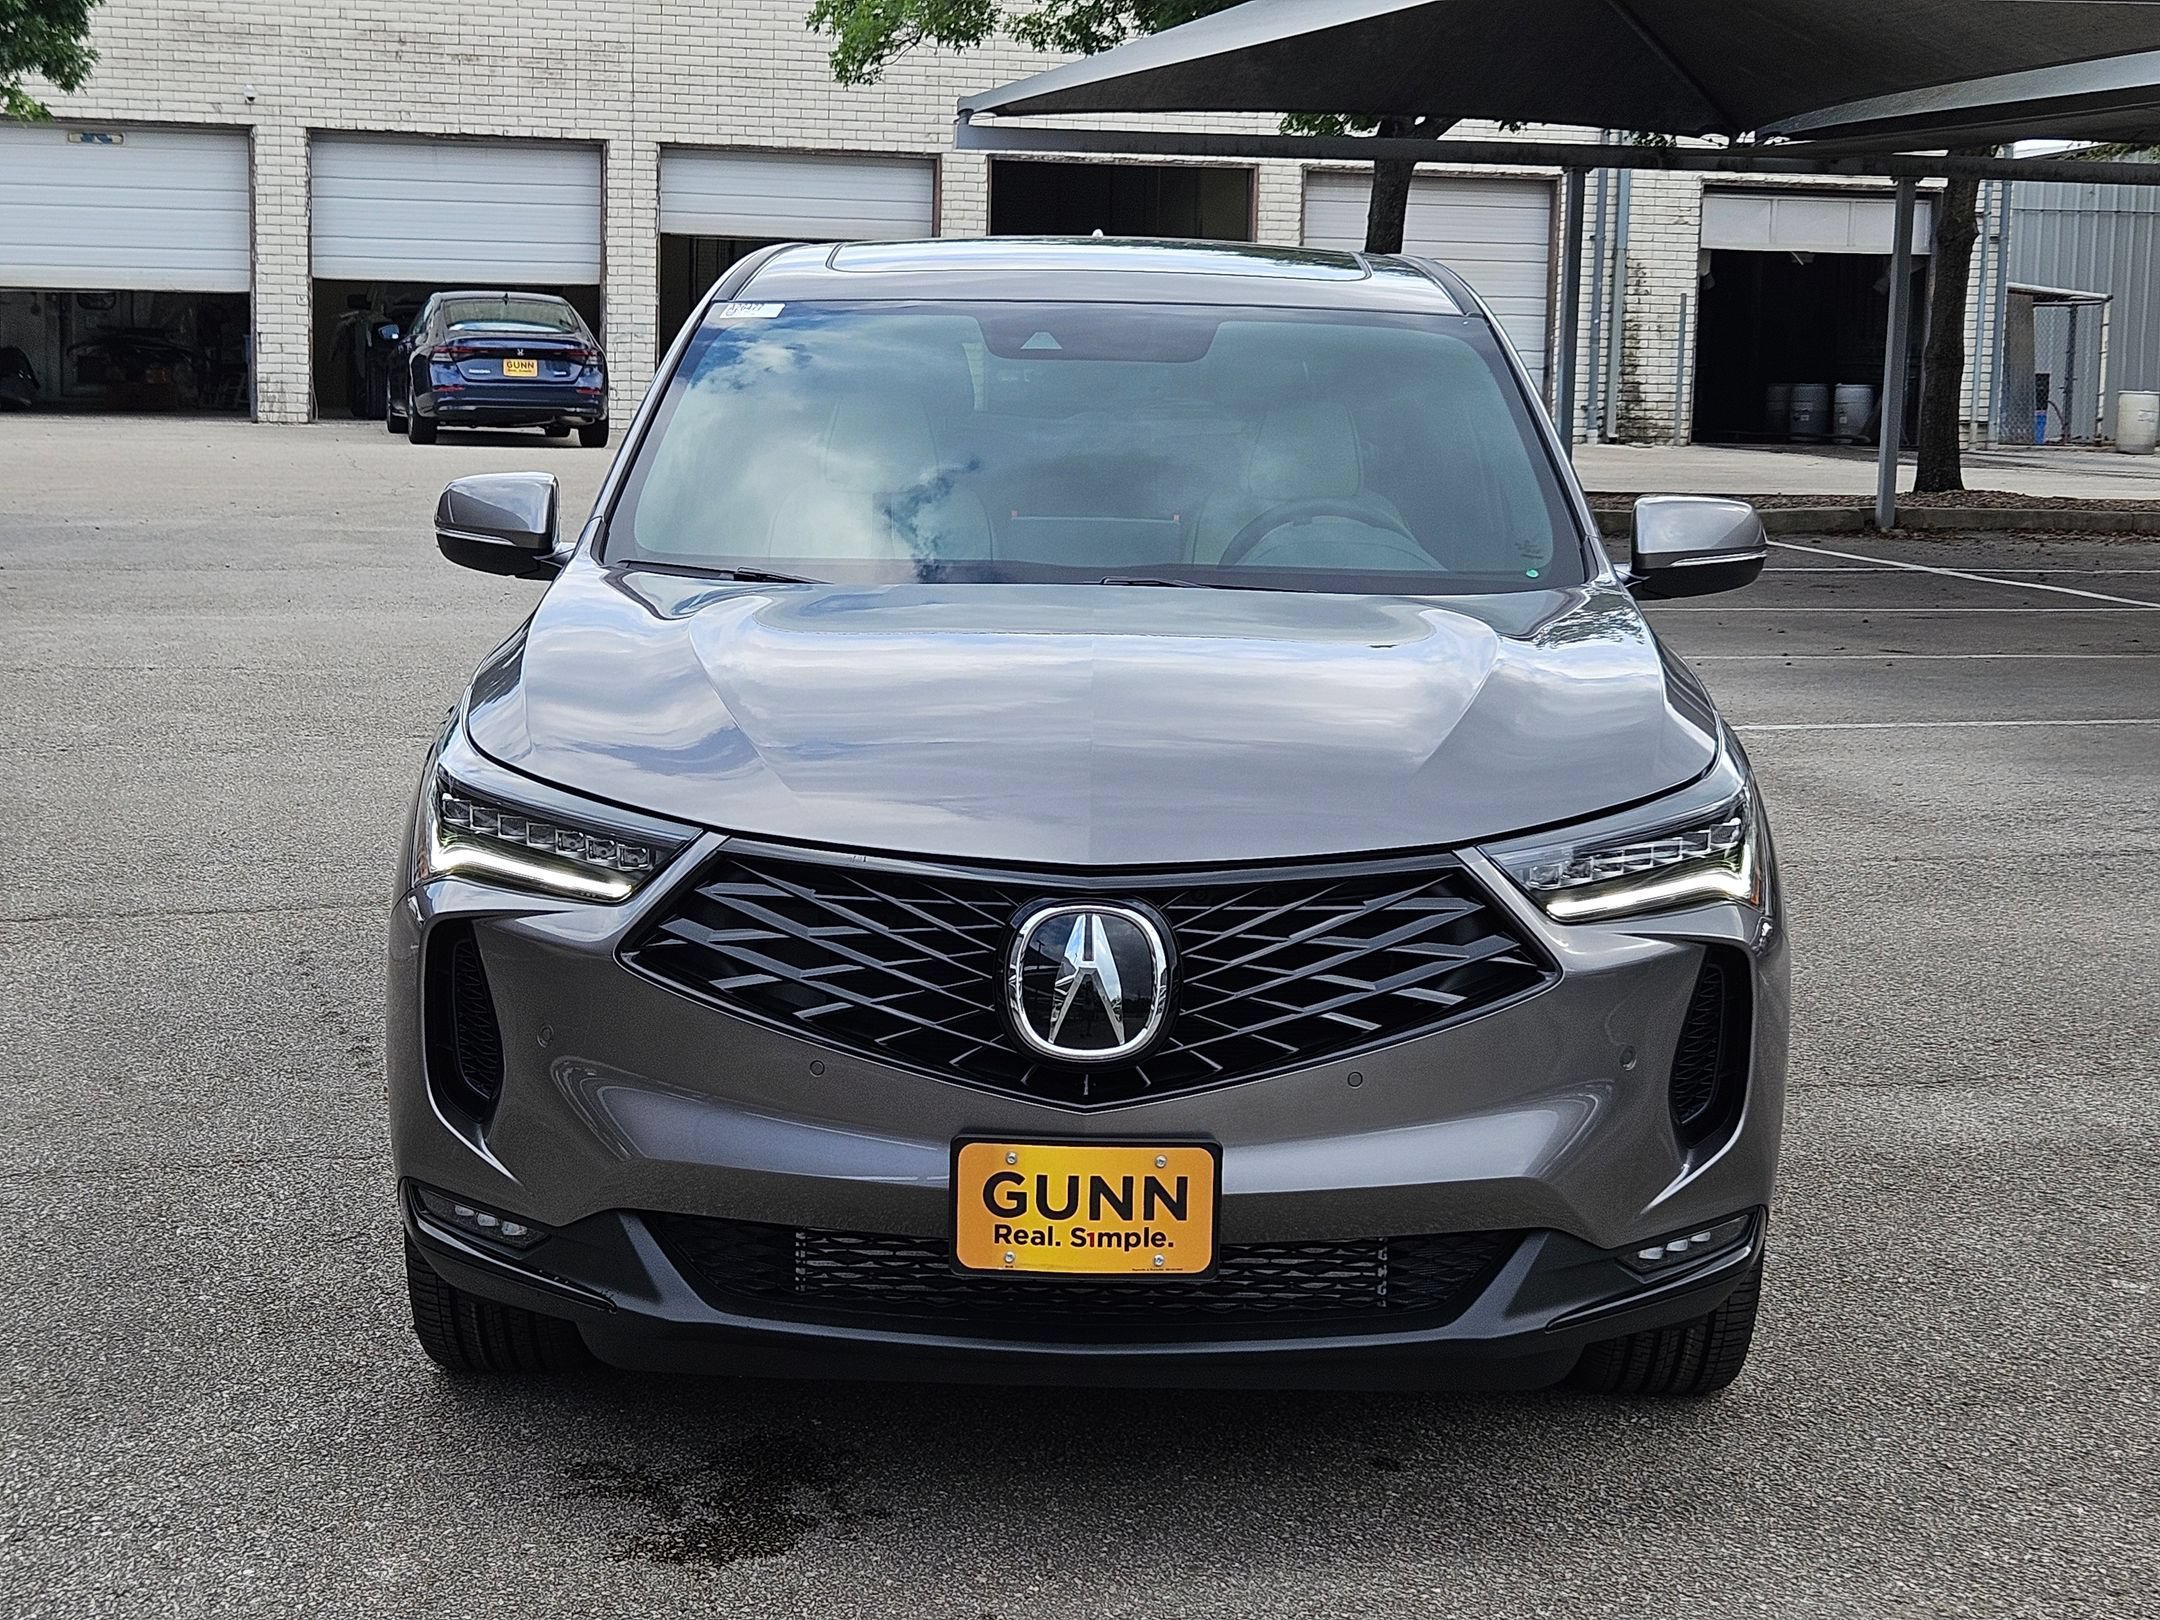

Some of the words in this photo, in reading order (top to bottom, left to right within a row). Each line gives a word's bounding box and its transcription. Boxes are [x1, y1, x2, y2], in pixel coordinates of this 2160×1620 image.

[506, 361, 535, 369] GUNN
[982, 1171, 1188, 1221] GUNN
[994, 1224, 1061, 1247] Real.
